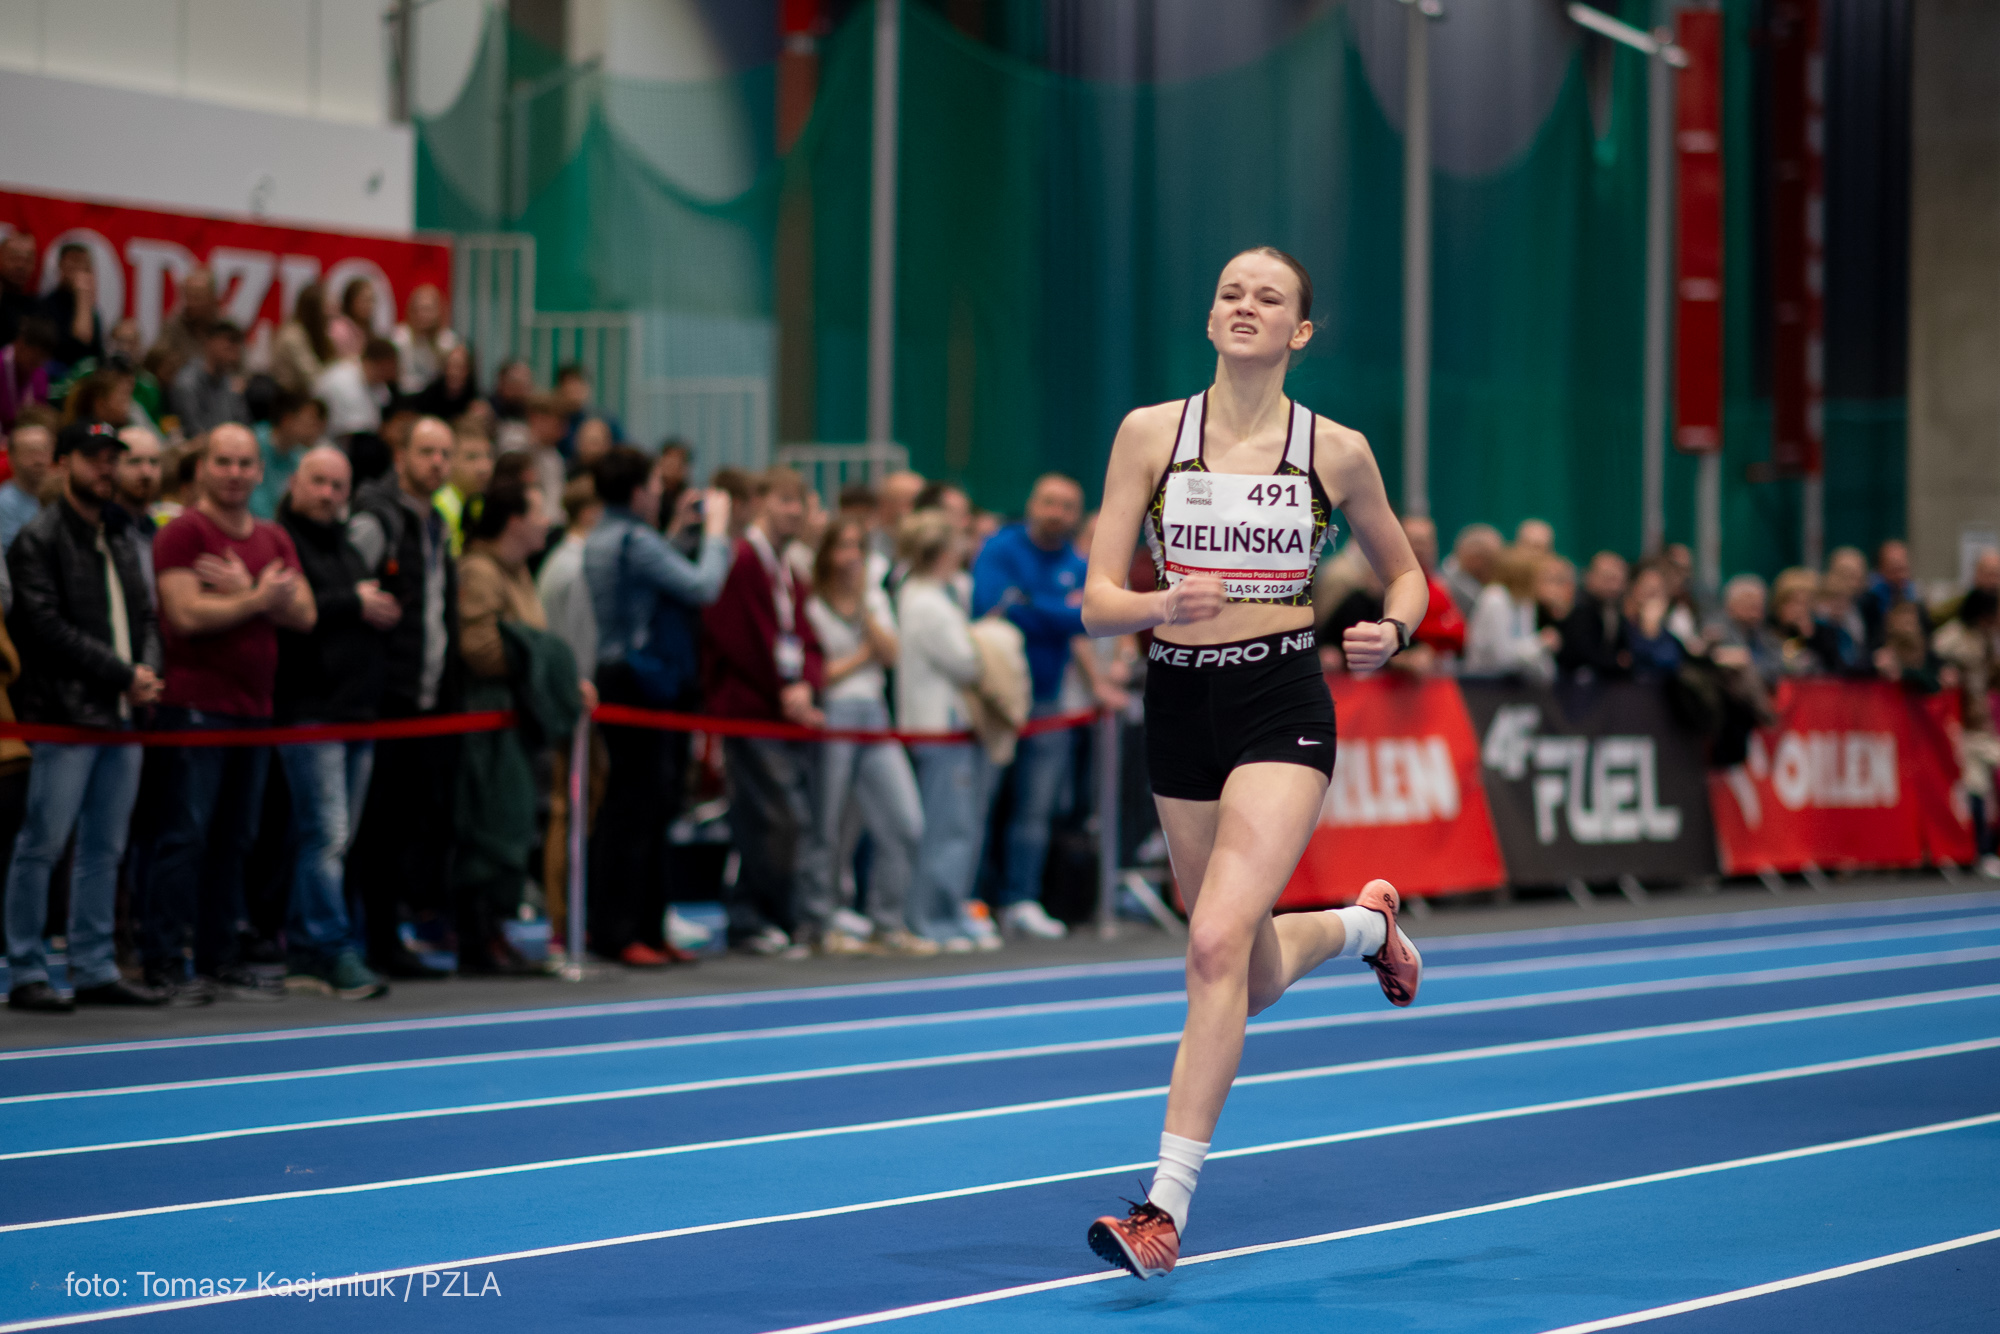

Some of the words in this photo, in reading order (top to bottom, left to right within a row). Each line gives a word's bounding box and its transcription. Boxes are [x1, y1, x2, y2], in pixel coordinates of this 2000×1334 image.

[1247, 483, 1300, 507] 491
[1169, 521, 1305, 554] ZIELIŃSKA
[1253, 571, 1274, 579] Polski
[1263, 584, 1293, 595] 2024
[1194, 642, 1271, 668] PRO
[1320, 734, 1461, 827] RLEN
[1532, 734, 1682, 845] FUEL
